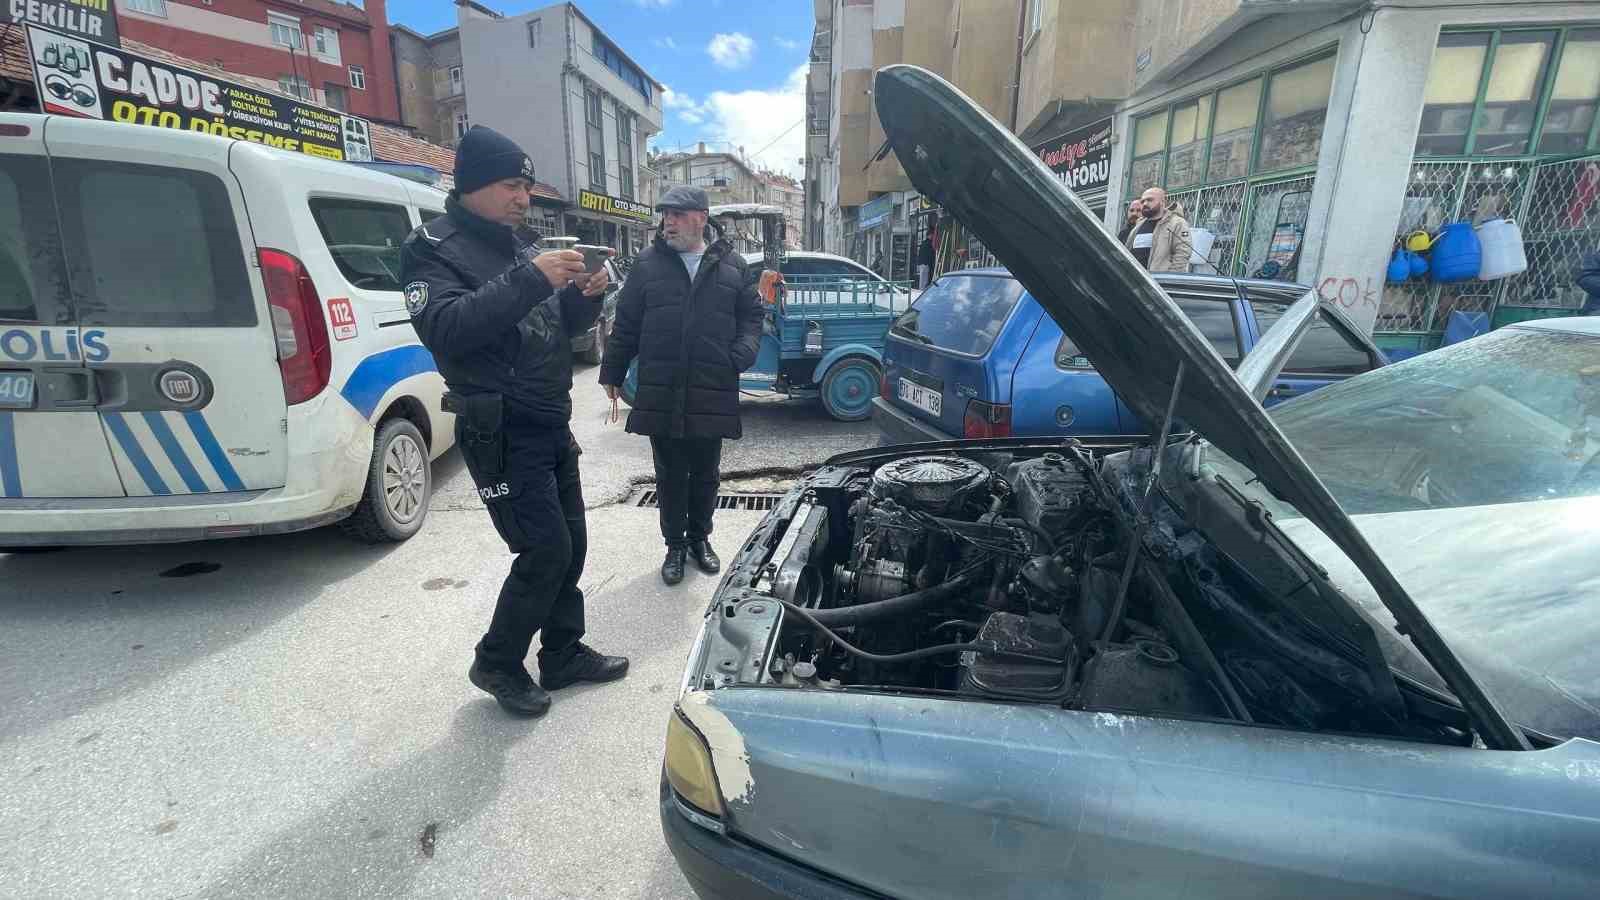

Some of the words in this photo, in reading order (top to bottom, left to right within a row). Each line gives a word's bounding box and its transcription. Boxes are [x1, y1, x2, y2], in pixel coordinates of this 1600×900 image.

[9, 0, 102, 36] ÇEKİLİR
[95, 51, 224, 115] CADDE
[332, 302, 351, 323] 112
